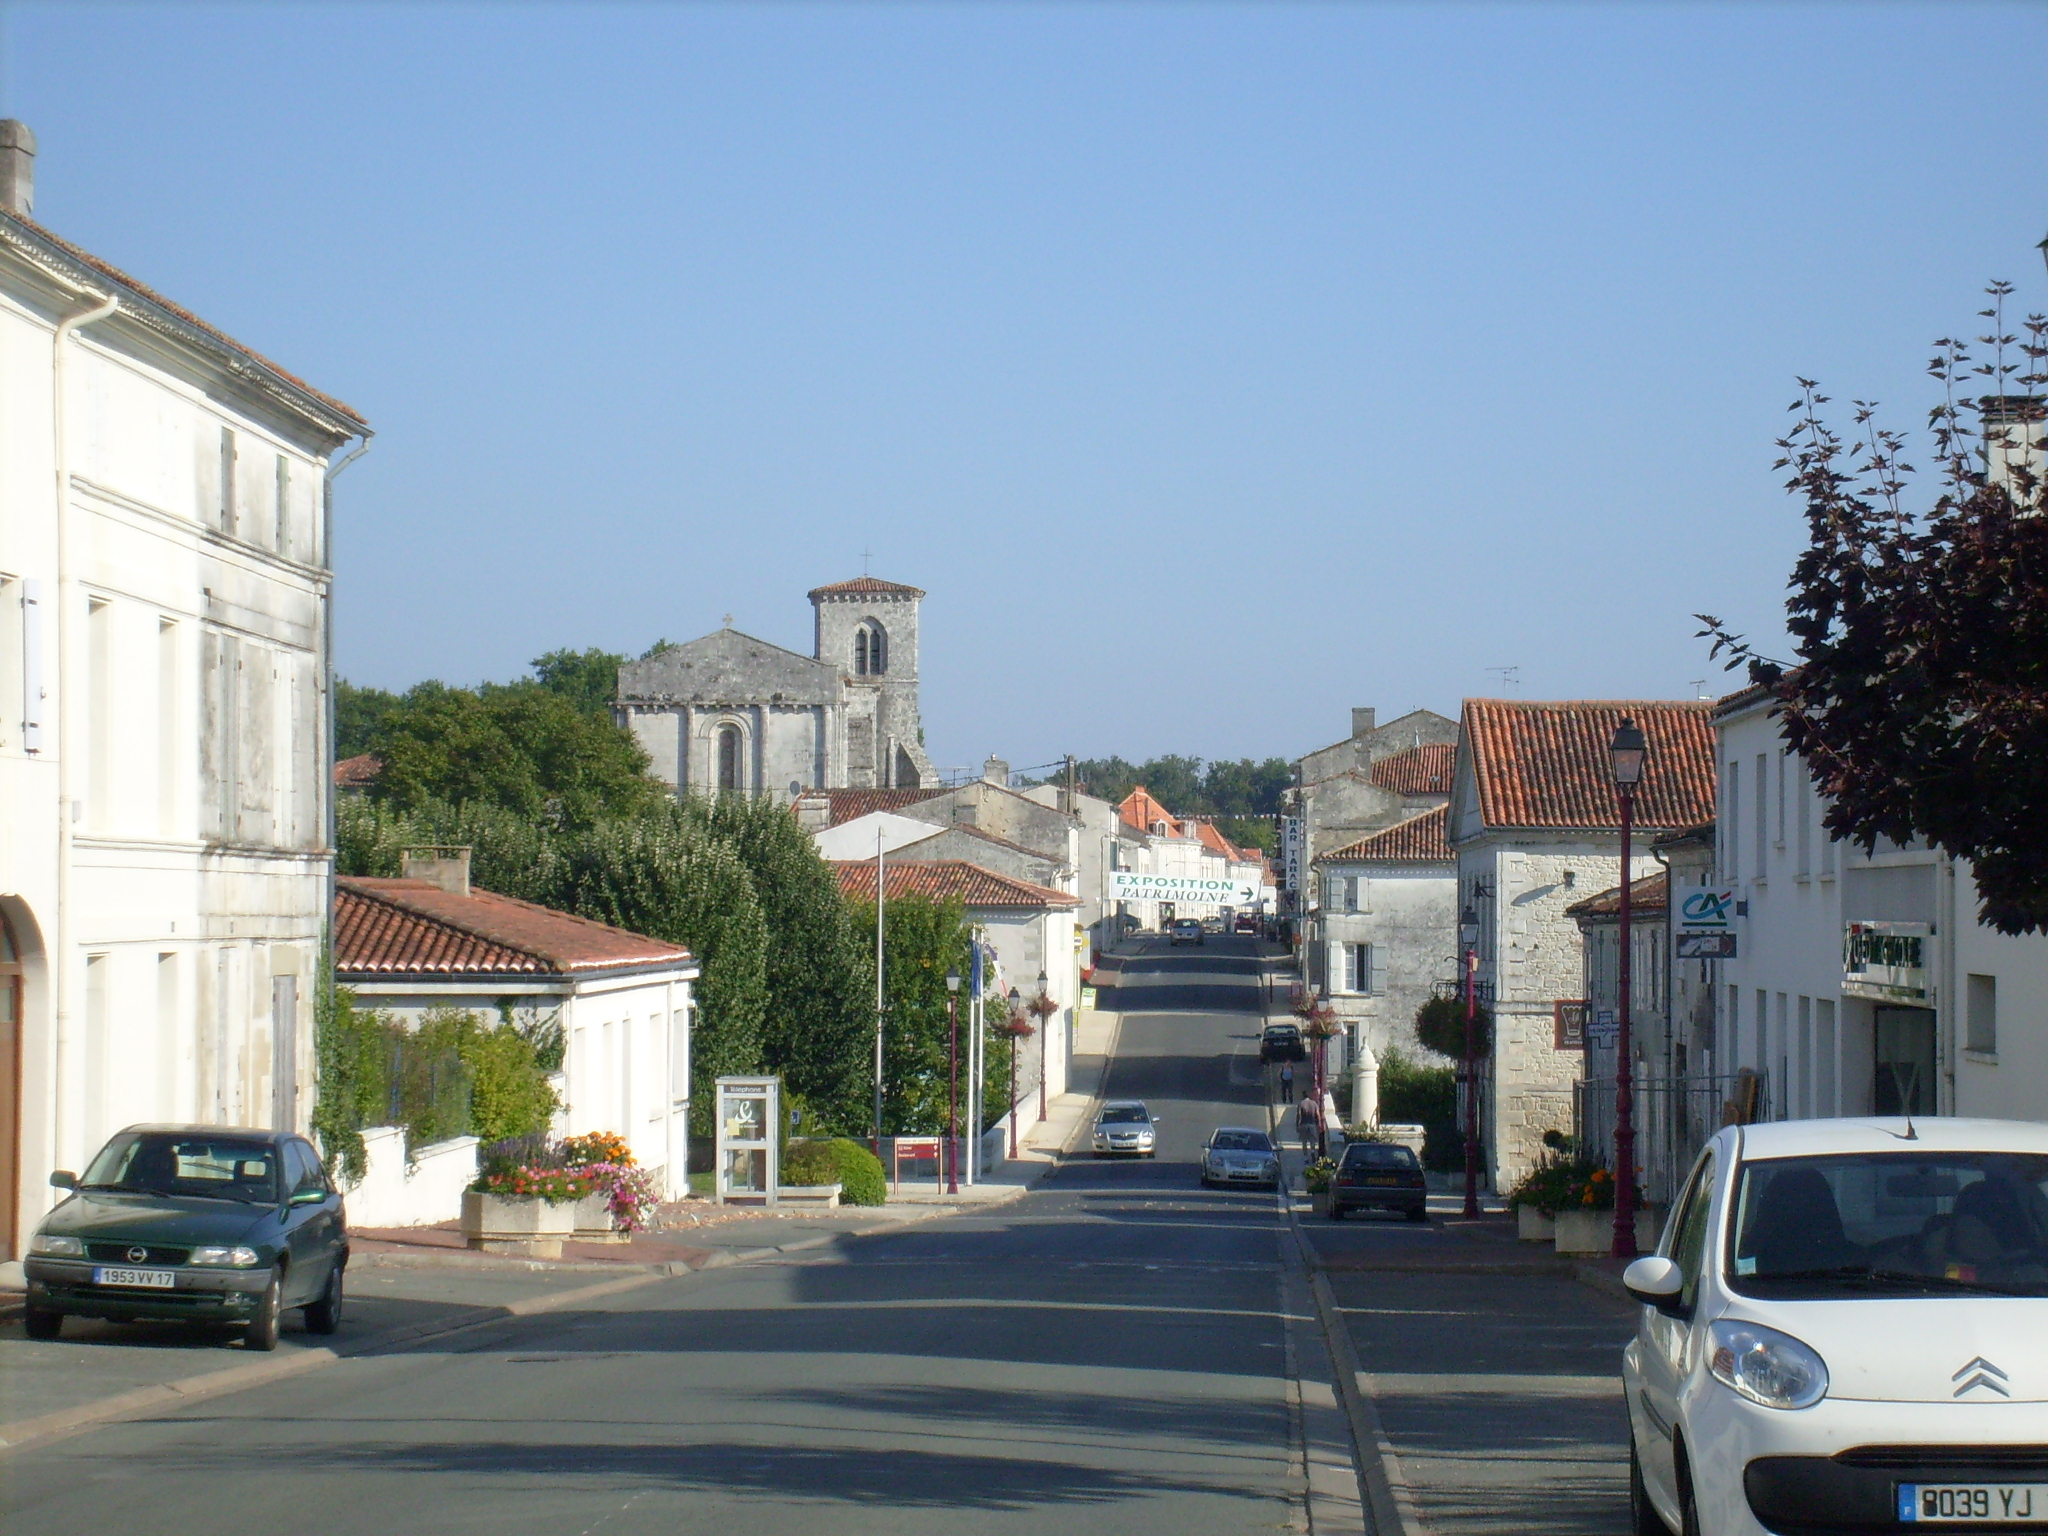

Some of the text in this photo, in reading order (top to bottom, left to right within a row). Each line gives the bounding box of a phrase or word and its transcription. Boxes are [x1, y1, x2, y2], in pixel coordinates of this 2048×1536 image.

[1289, 819, 1298, 889] BAR TABAC
[1116, 875, 1234, 891] EXPOSITION
[1121, 887, 1230, 903] PATRIMOINE
[104, 1269, 172, 1286] 1953 VV 17
[1922, 1489, 2031, 1517] 8039 YJ
